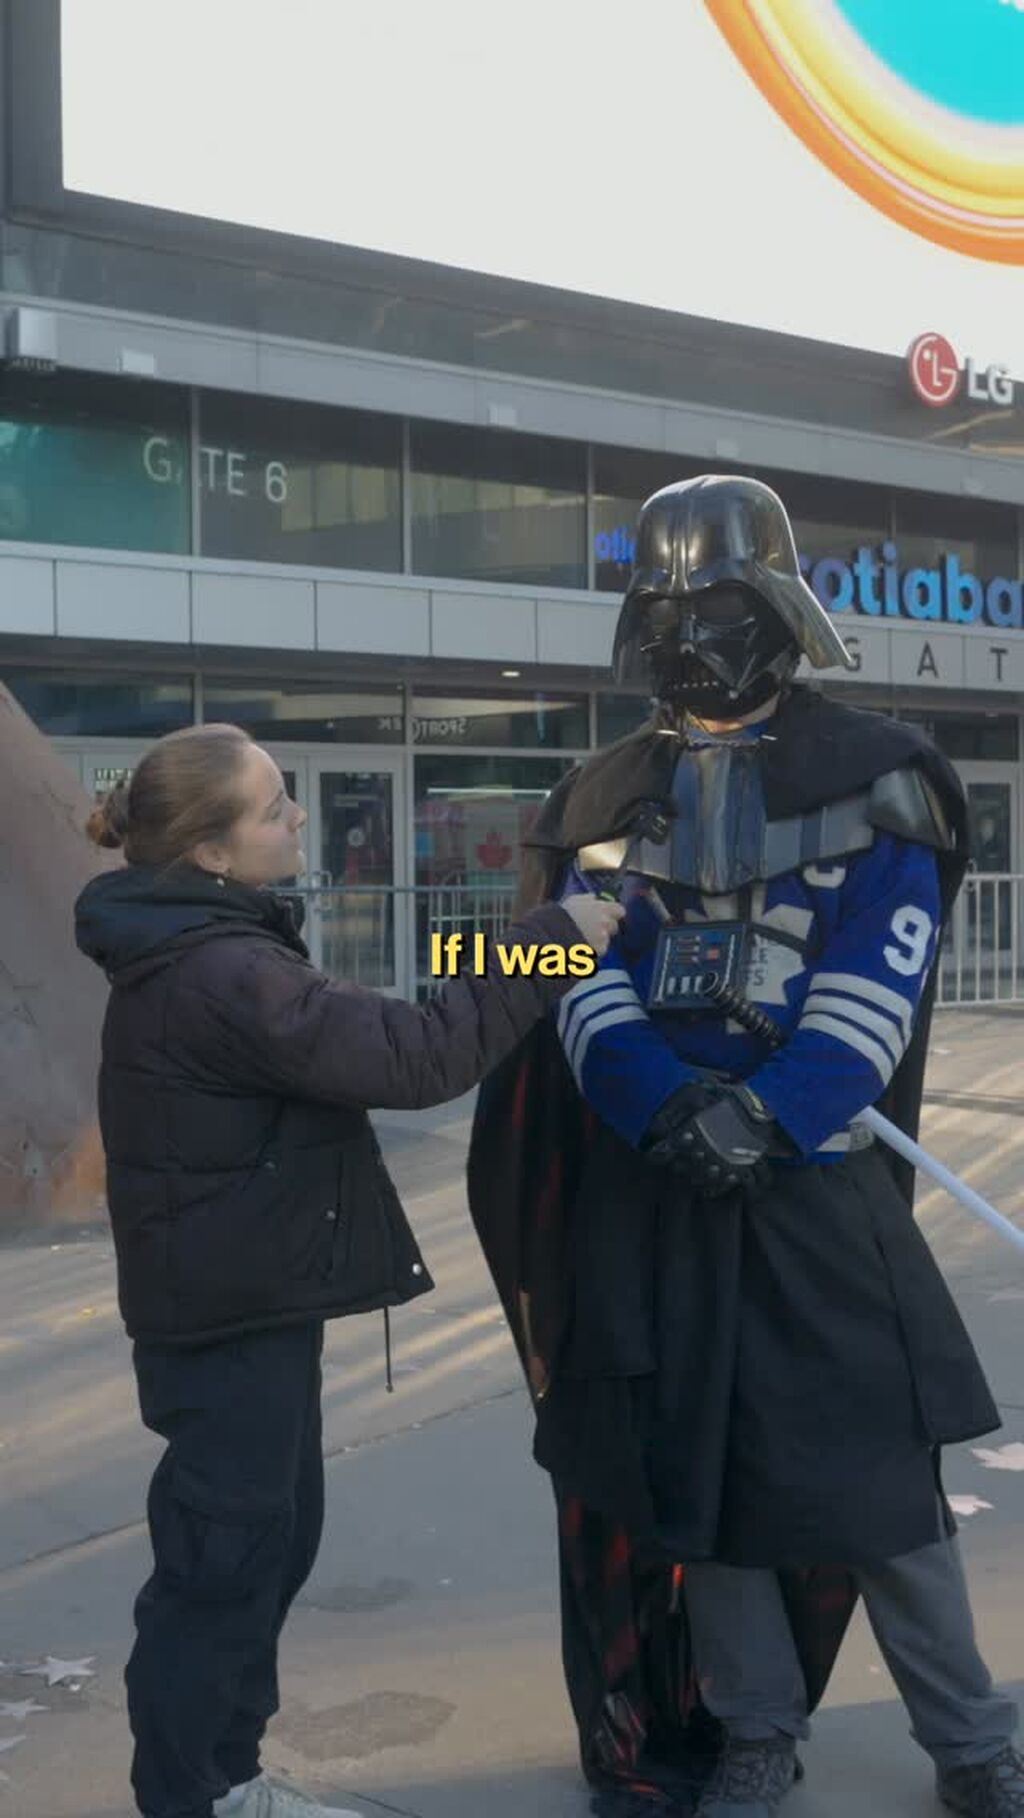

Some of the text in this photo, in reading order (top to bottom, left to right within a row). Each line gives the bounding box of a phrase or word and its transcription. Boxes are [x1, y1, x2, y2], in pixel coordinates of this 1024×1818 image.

[965, 357, 1013, 405] LG
[143, 437, 288, 503] GTE 6
[799, 538, 1024, 628] otiaba
[882, 904, 940, 977] 9
